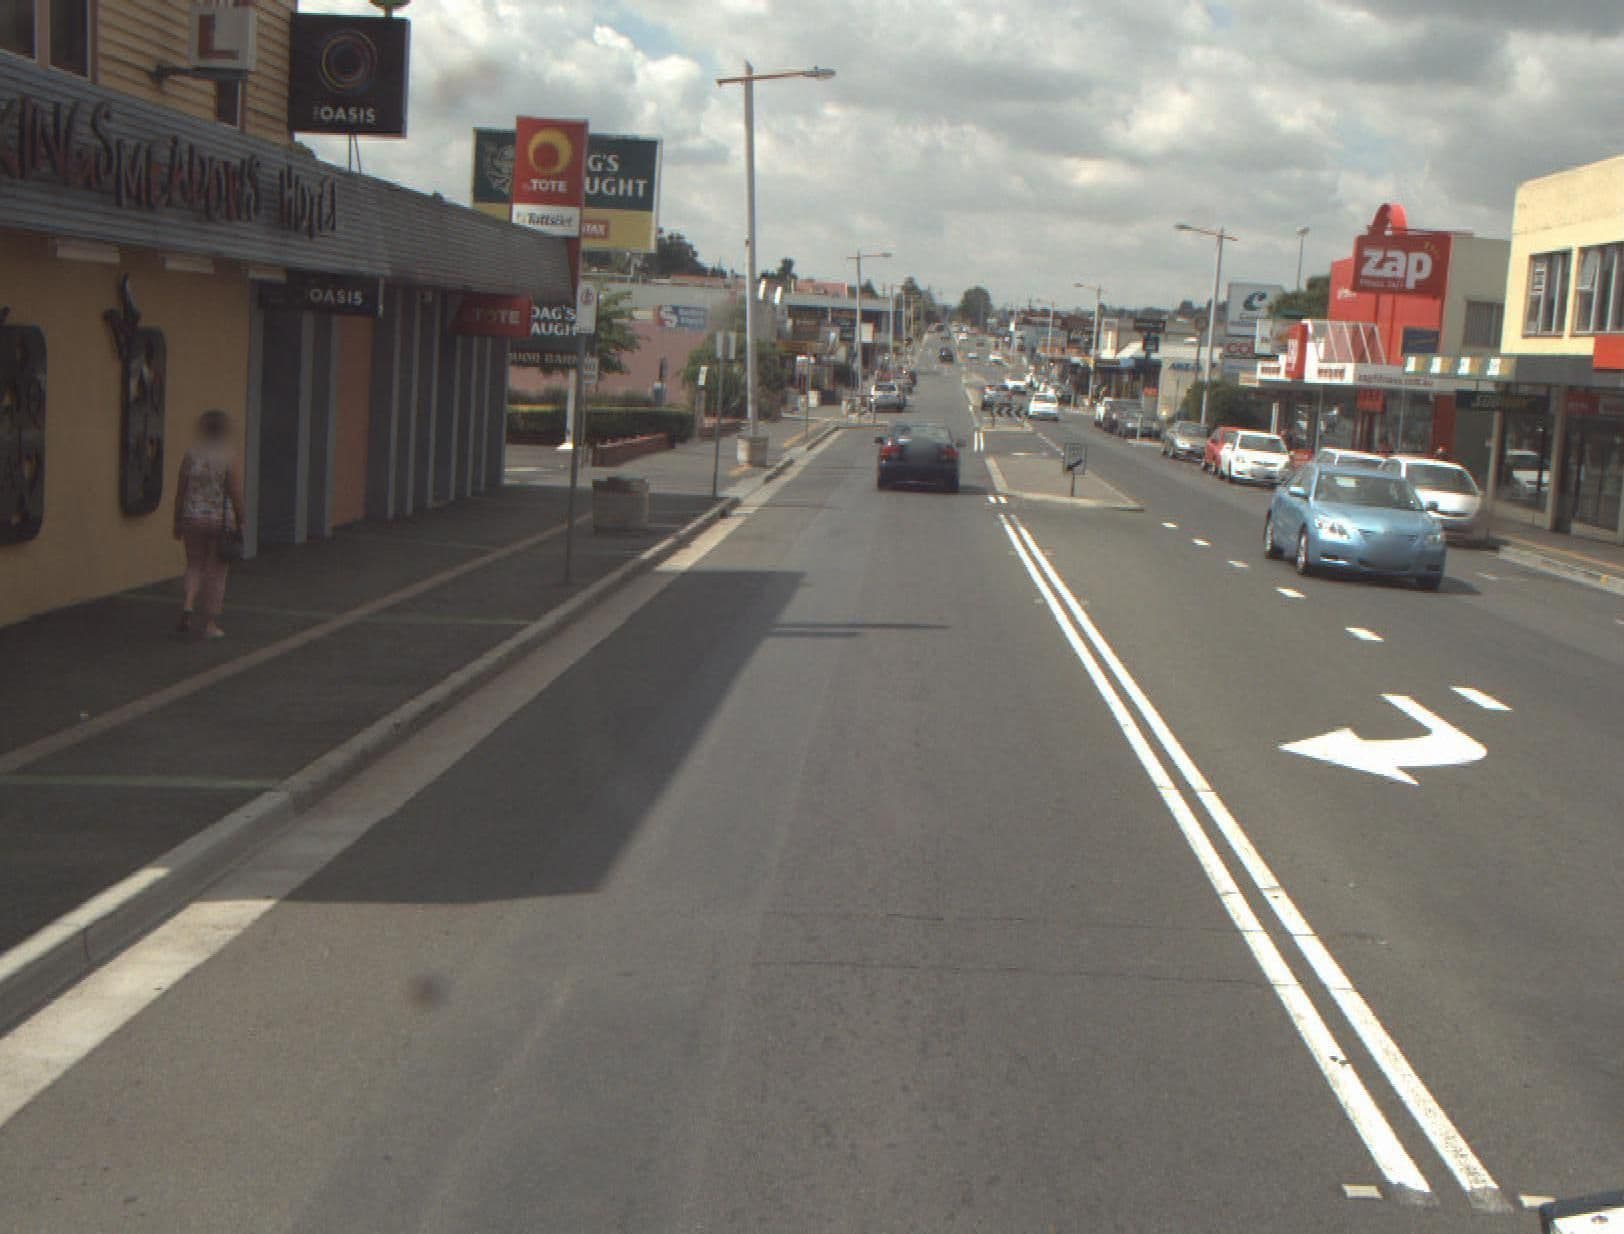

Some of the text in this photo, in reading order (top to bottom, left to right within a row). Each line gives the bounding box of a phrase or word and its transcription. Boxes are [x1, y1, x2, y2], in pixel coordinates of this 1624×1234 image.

[320, 106, 376, 124] OASIS
[529, 178, 568, 193] TOTE
[1360, 248, 1433, 290] zap
[309, 288, 363, 306] OASIS
